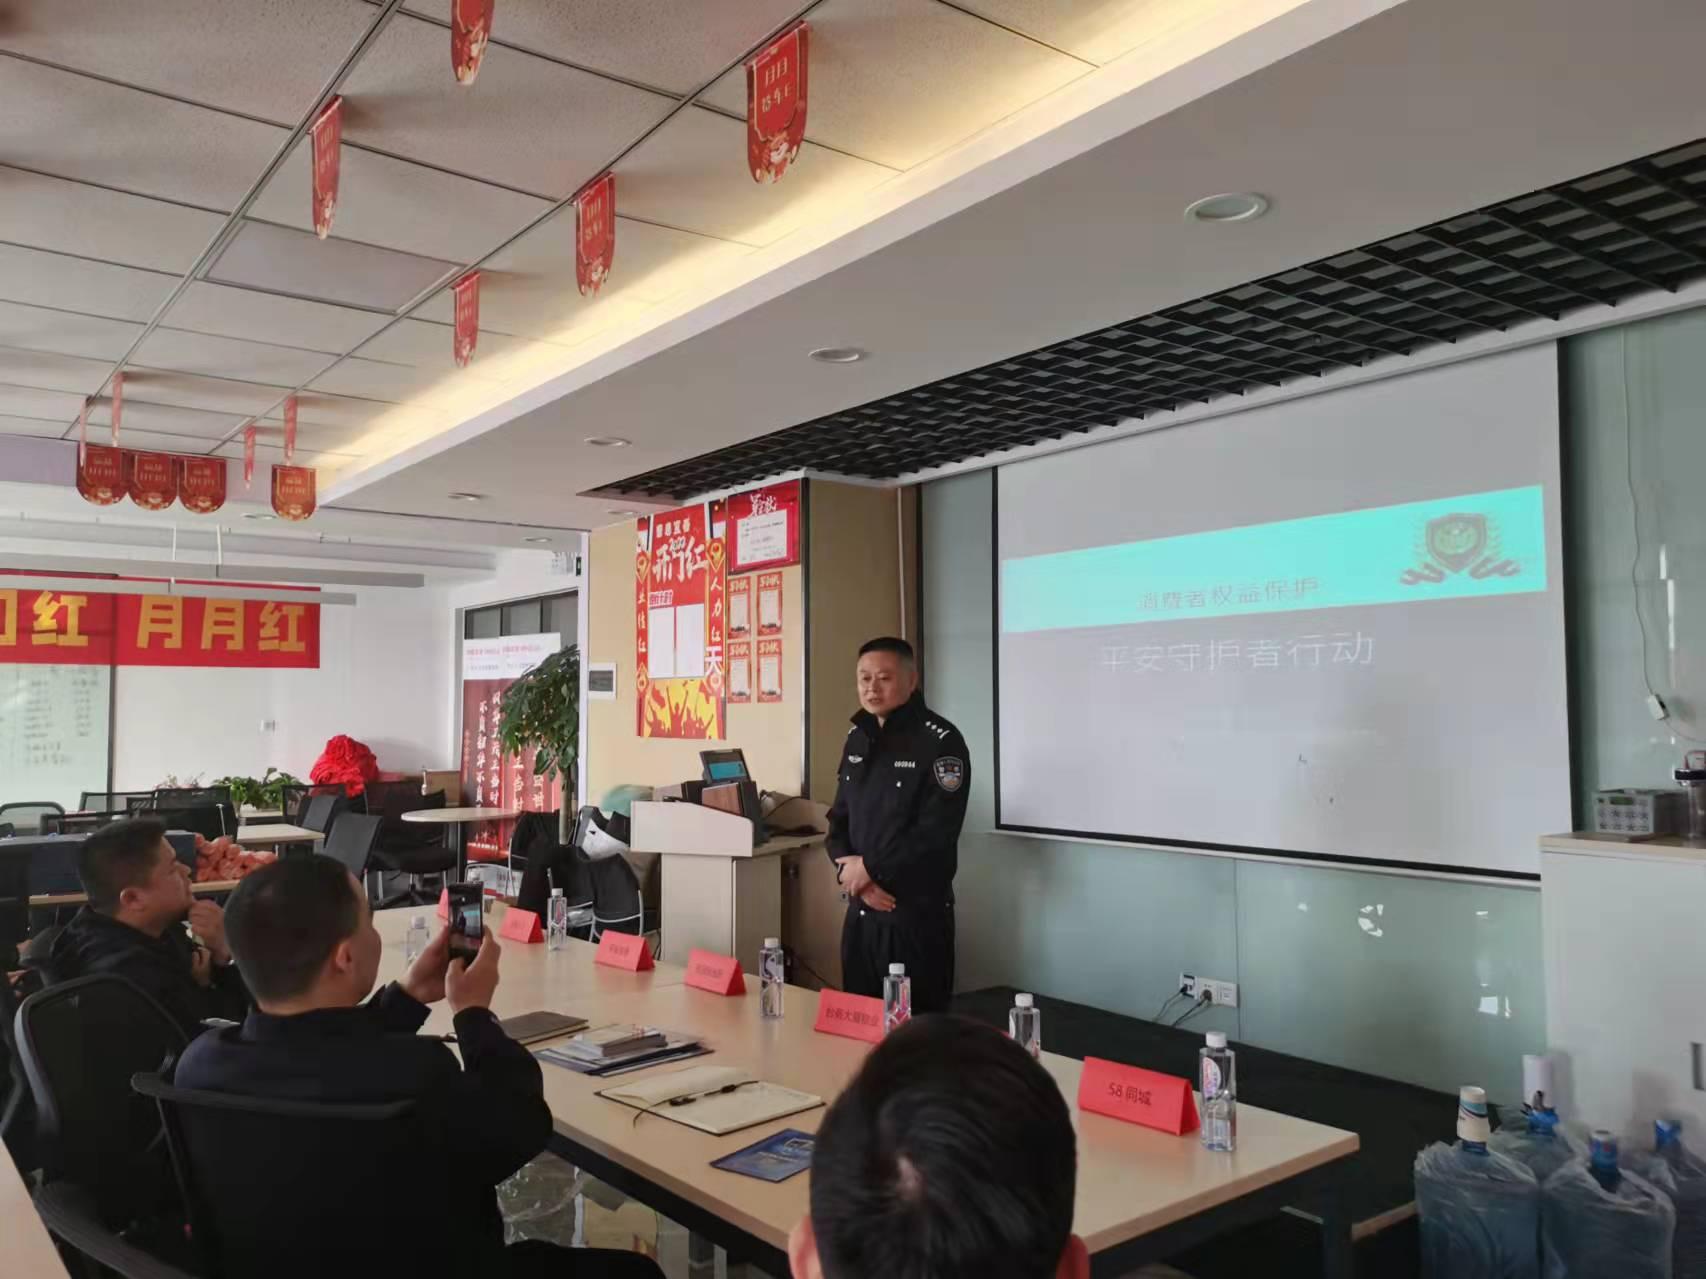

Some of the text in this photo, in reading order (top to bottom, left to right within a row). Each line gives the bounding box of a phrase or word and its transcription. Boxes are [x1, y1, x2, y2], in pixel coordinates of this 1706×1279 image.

[137, 594, 306, 652] 月月红
[1103, 631, 1374, 673] 平安守护者行动
[1109, 1082, 1152, 1105] 58 同城
